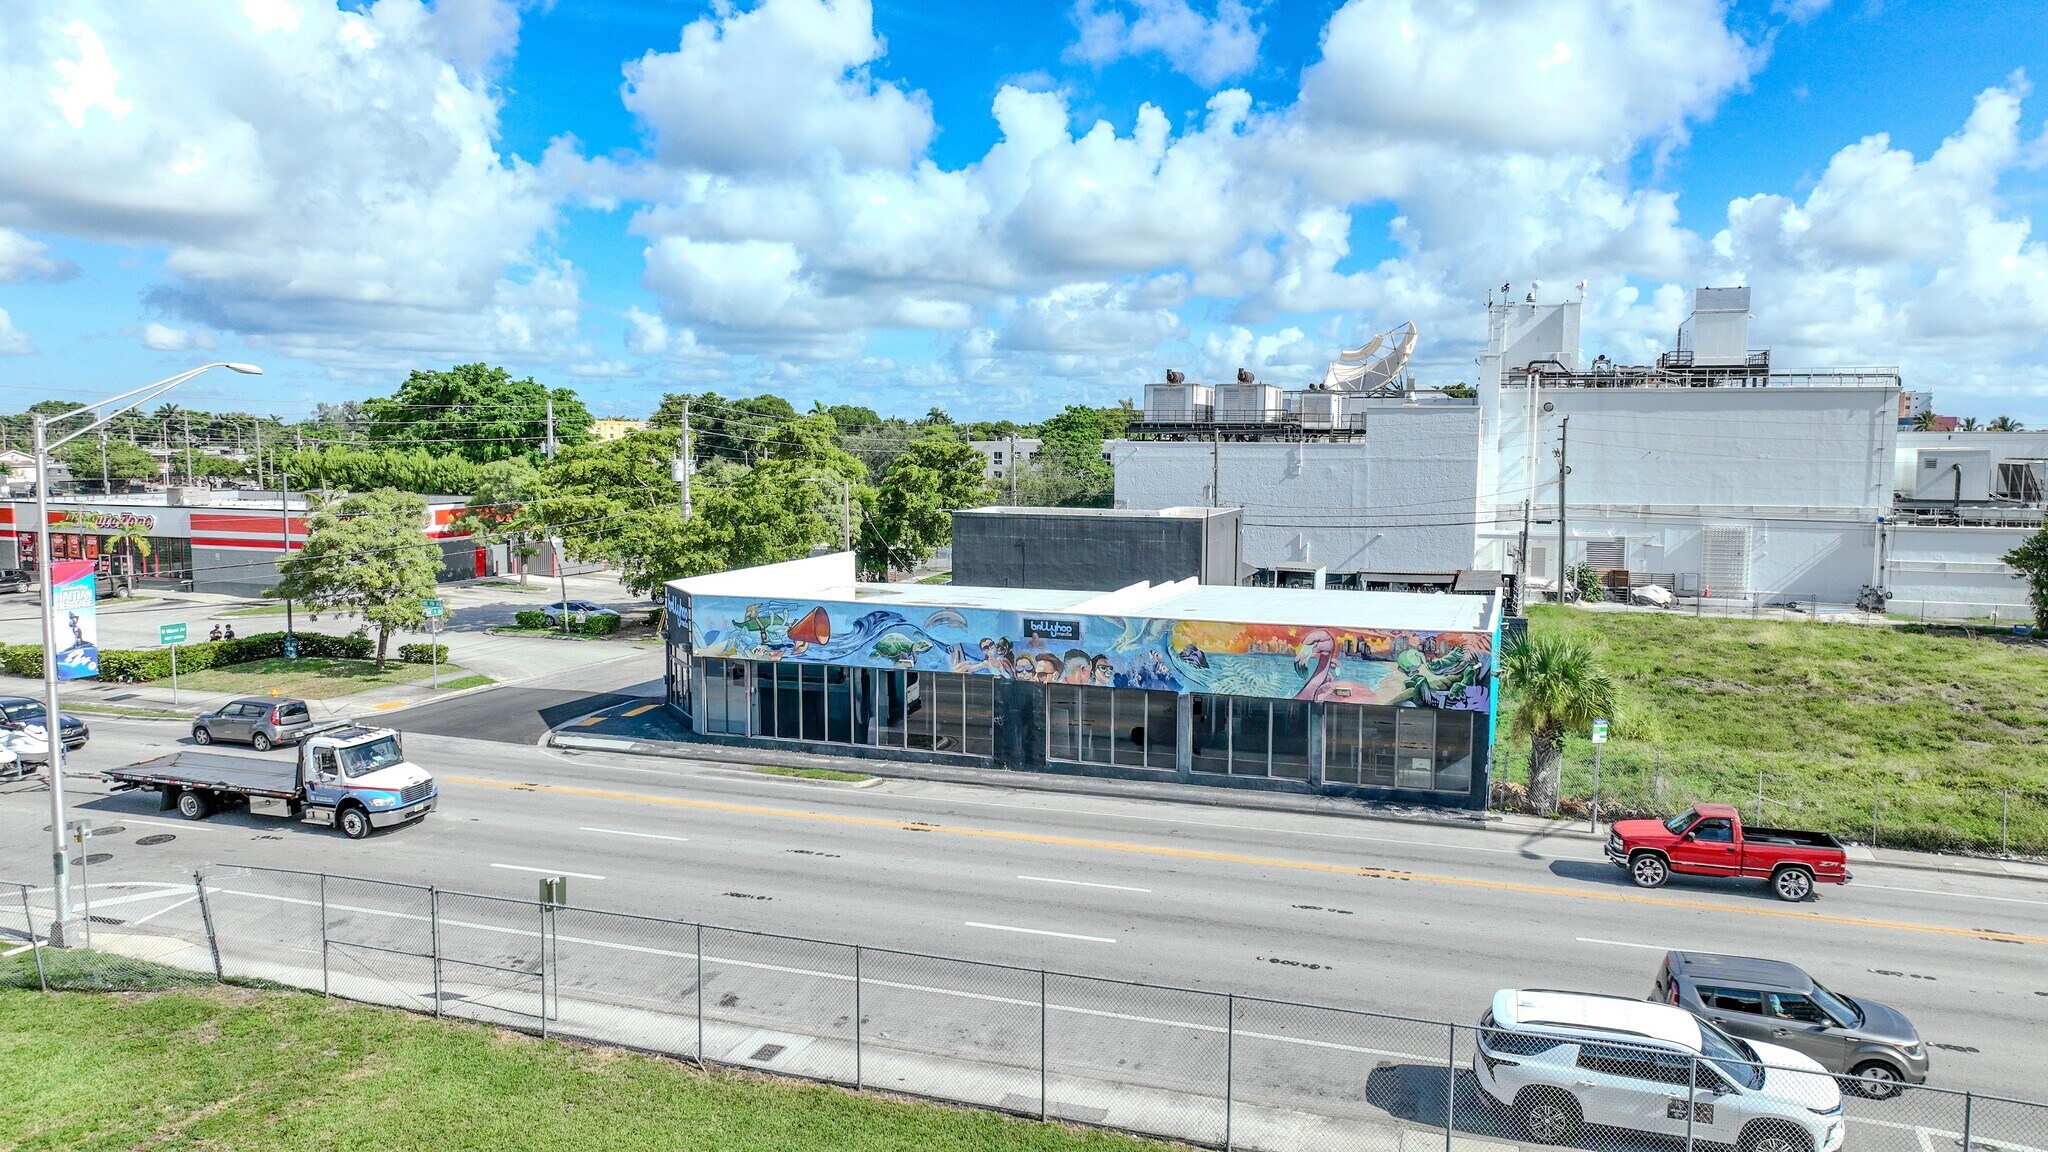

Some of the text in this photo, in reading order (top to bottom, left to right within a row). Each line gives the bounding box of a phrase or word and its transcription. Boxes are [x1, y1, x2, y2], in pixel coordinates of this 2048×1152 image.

[56, 589, 92, 602] HAITIAN
[56, 599, 94, 611] HERITAGE
[1031, 620, 1072, 637] ballyhoo
